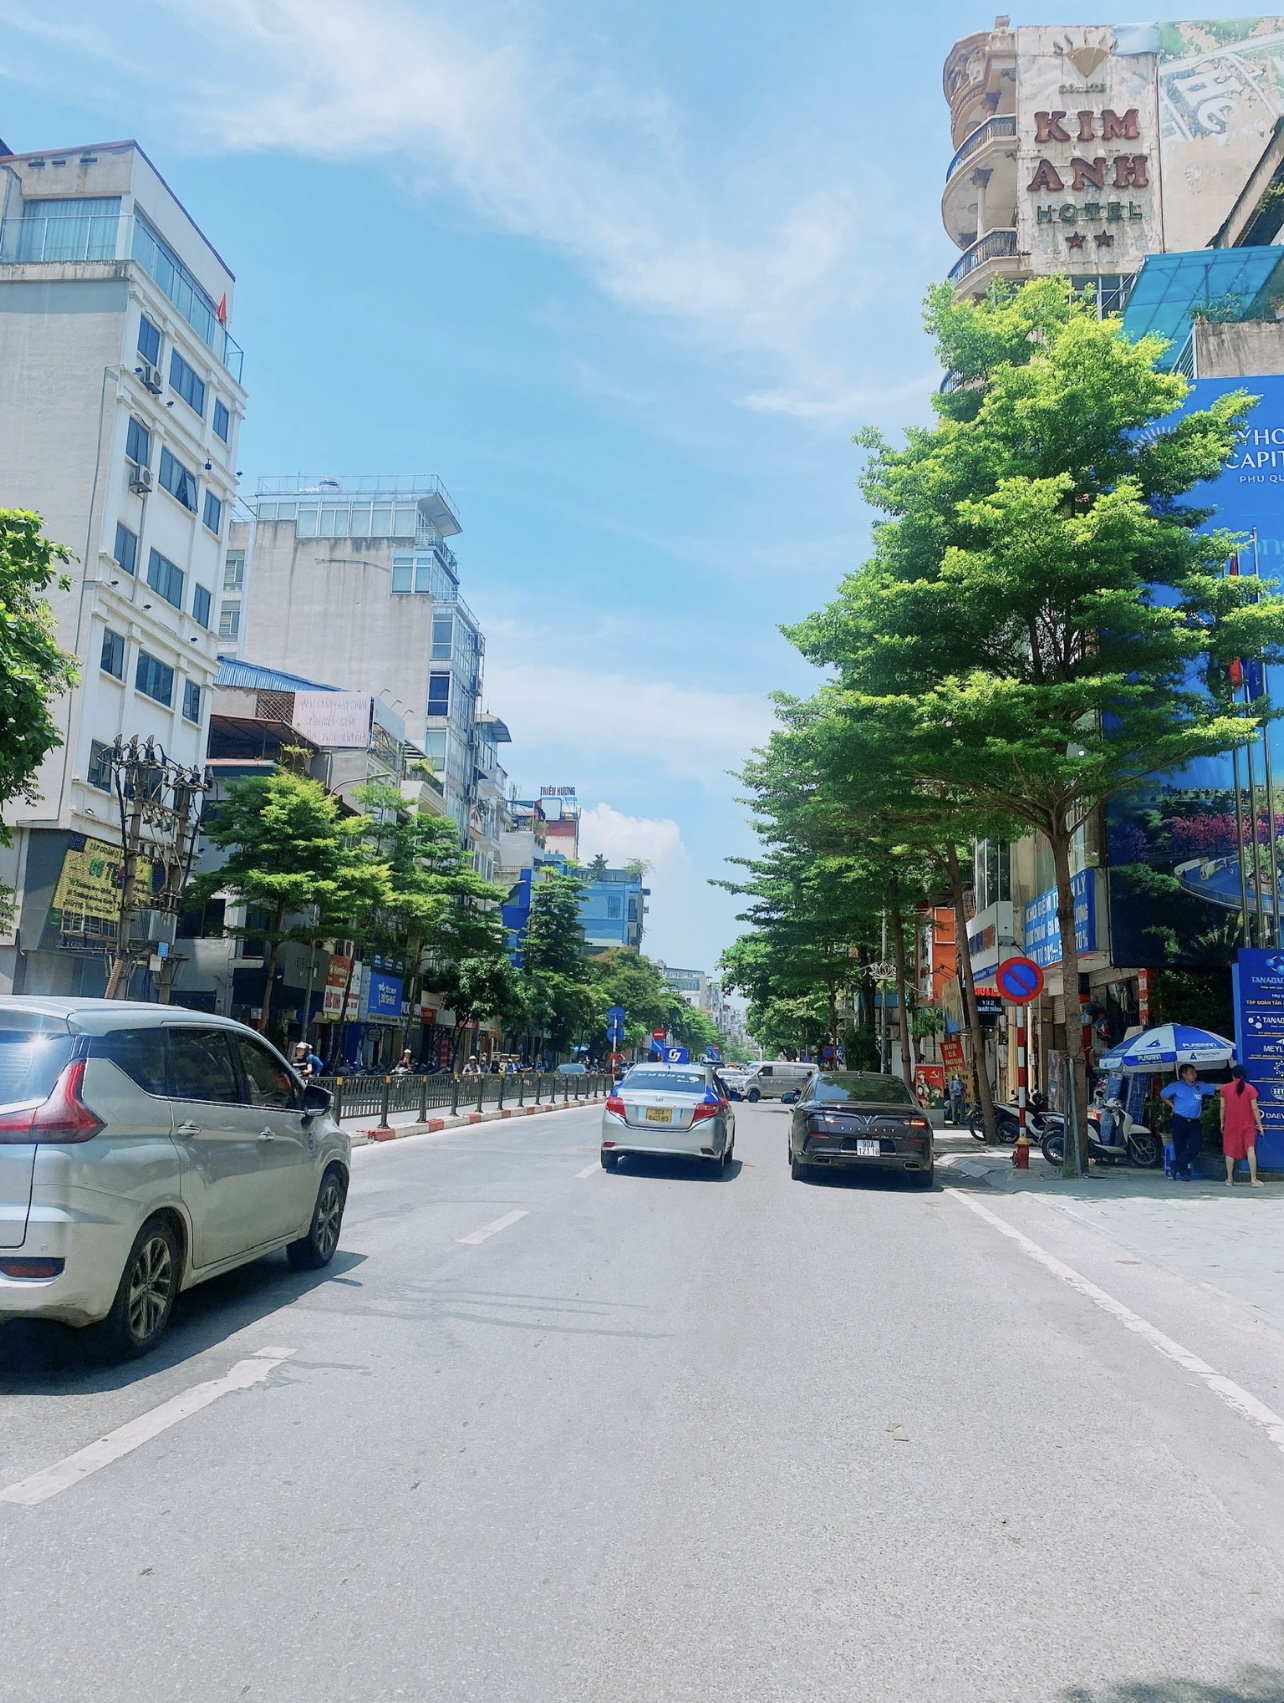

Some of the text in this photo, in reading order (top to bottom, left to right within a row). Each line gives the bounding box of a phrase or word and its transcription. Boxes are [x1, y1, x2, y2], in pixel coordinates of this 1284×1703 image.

[1034, 108, 1140, 143] KIM
[1026, 155, 1149, 192] ANH
[1036, 201, 1143, 224] HOTEL
[1239, 475, 1265, 483] PHU
[668, 1049, 681, 1062] G7
